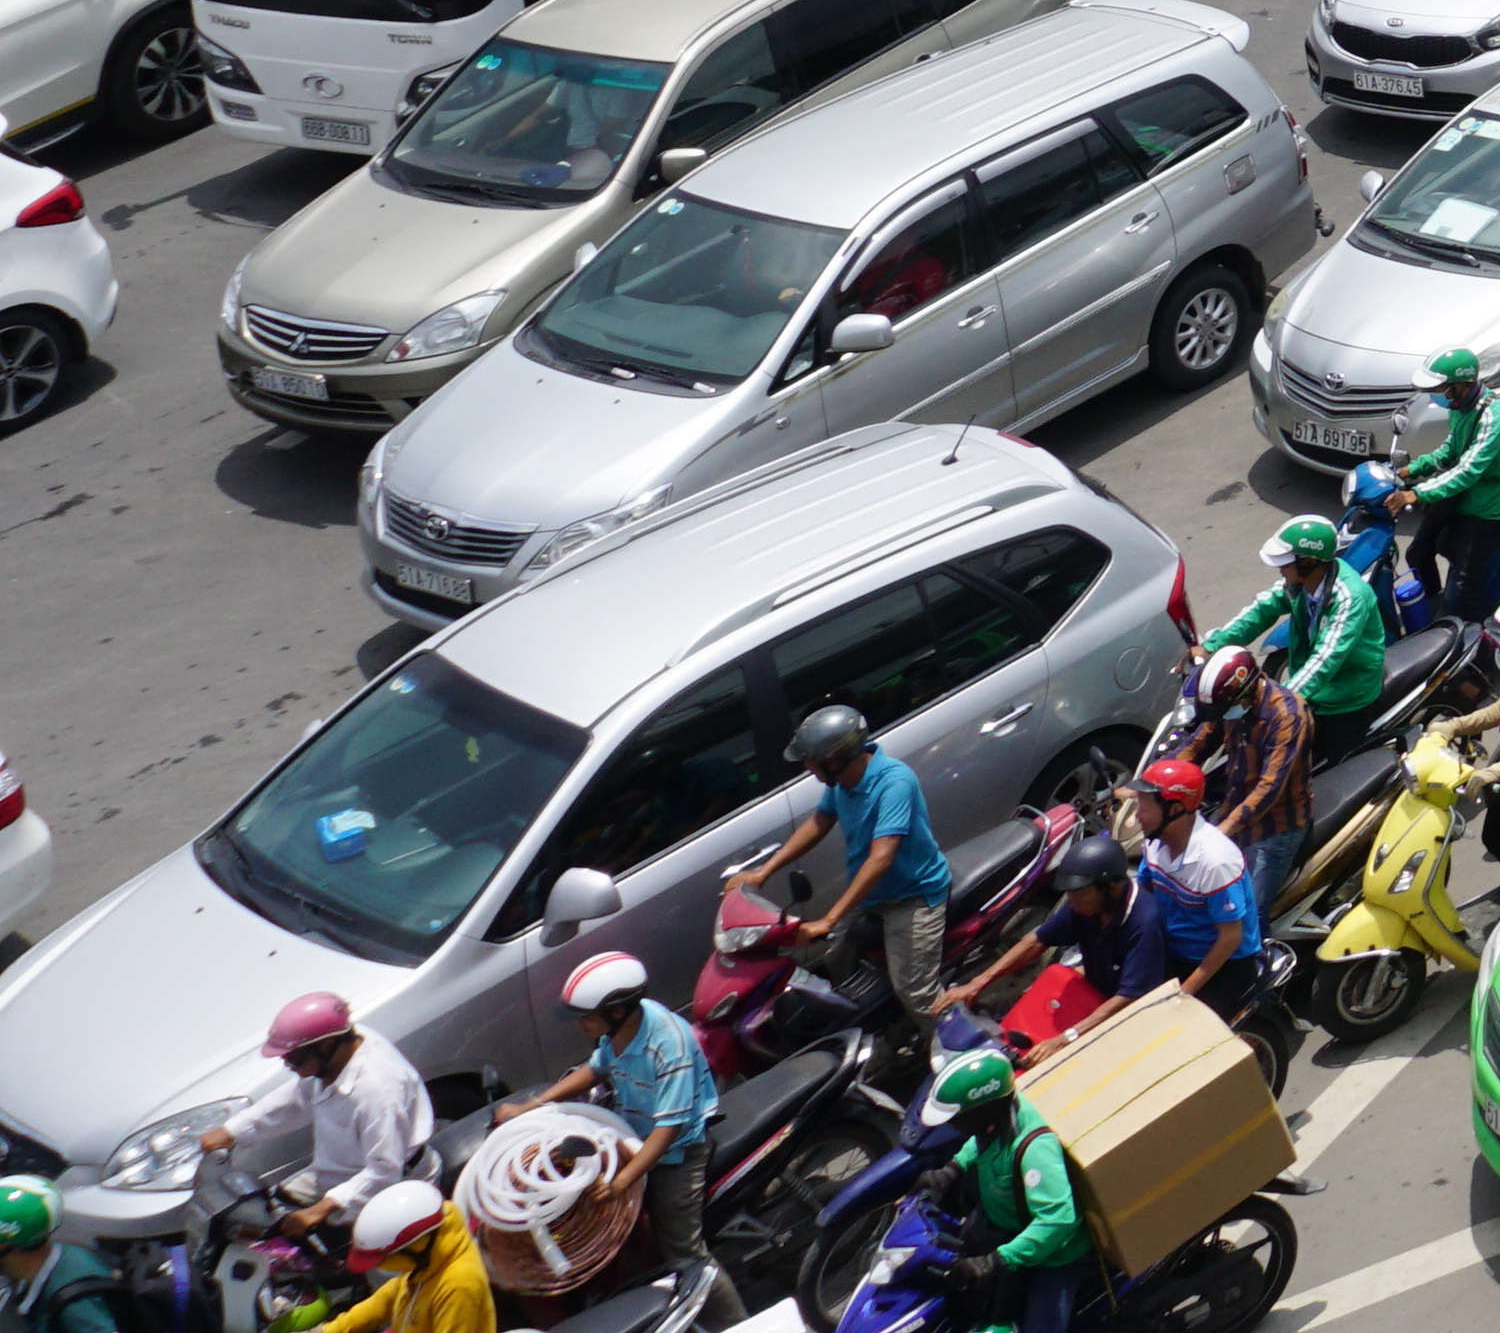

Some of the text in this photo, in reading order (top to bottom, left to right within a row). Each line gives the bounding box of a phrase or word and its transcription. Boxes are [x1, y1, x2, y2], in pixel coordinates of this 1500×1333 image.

[1456, 364, 1476, 376] Grab
[1299, 537, 1324, 550] Grab
[968, 1078, 1001, 1099] Grab
